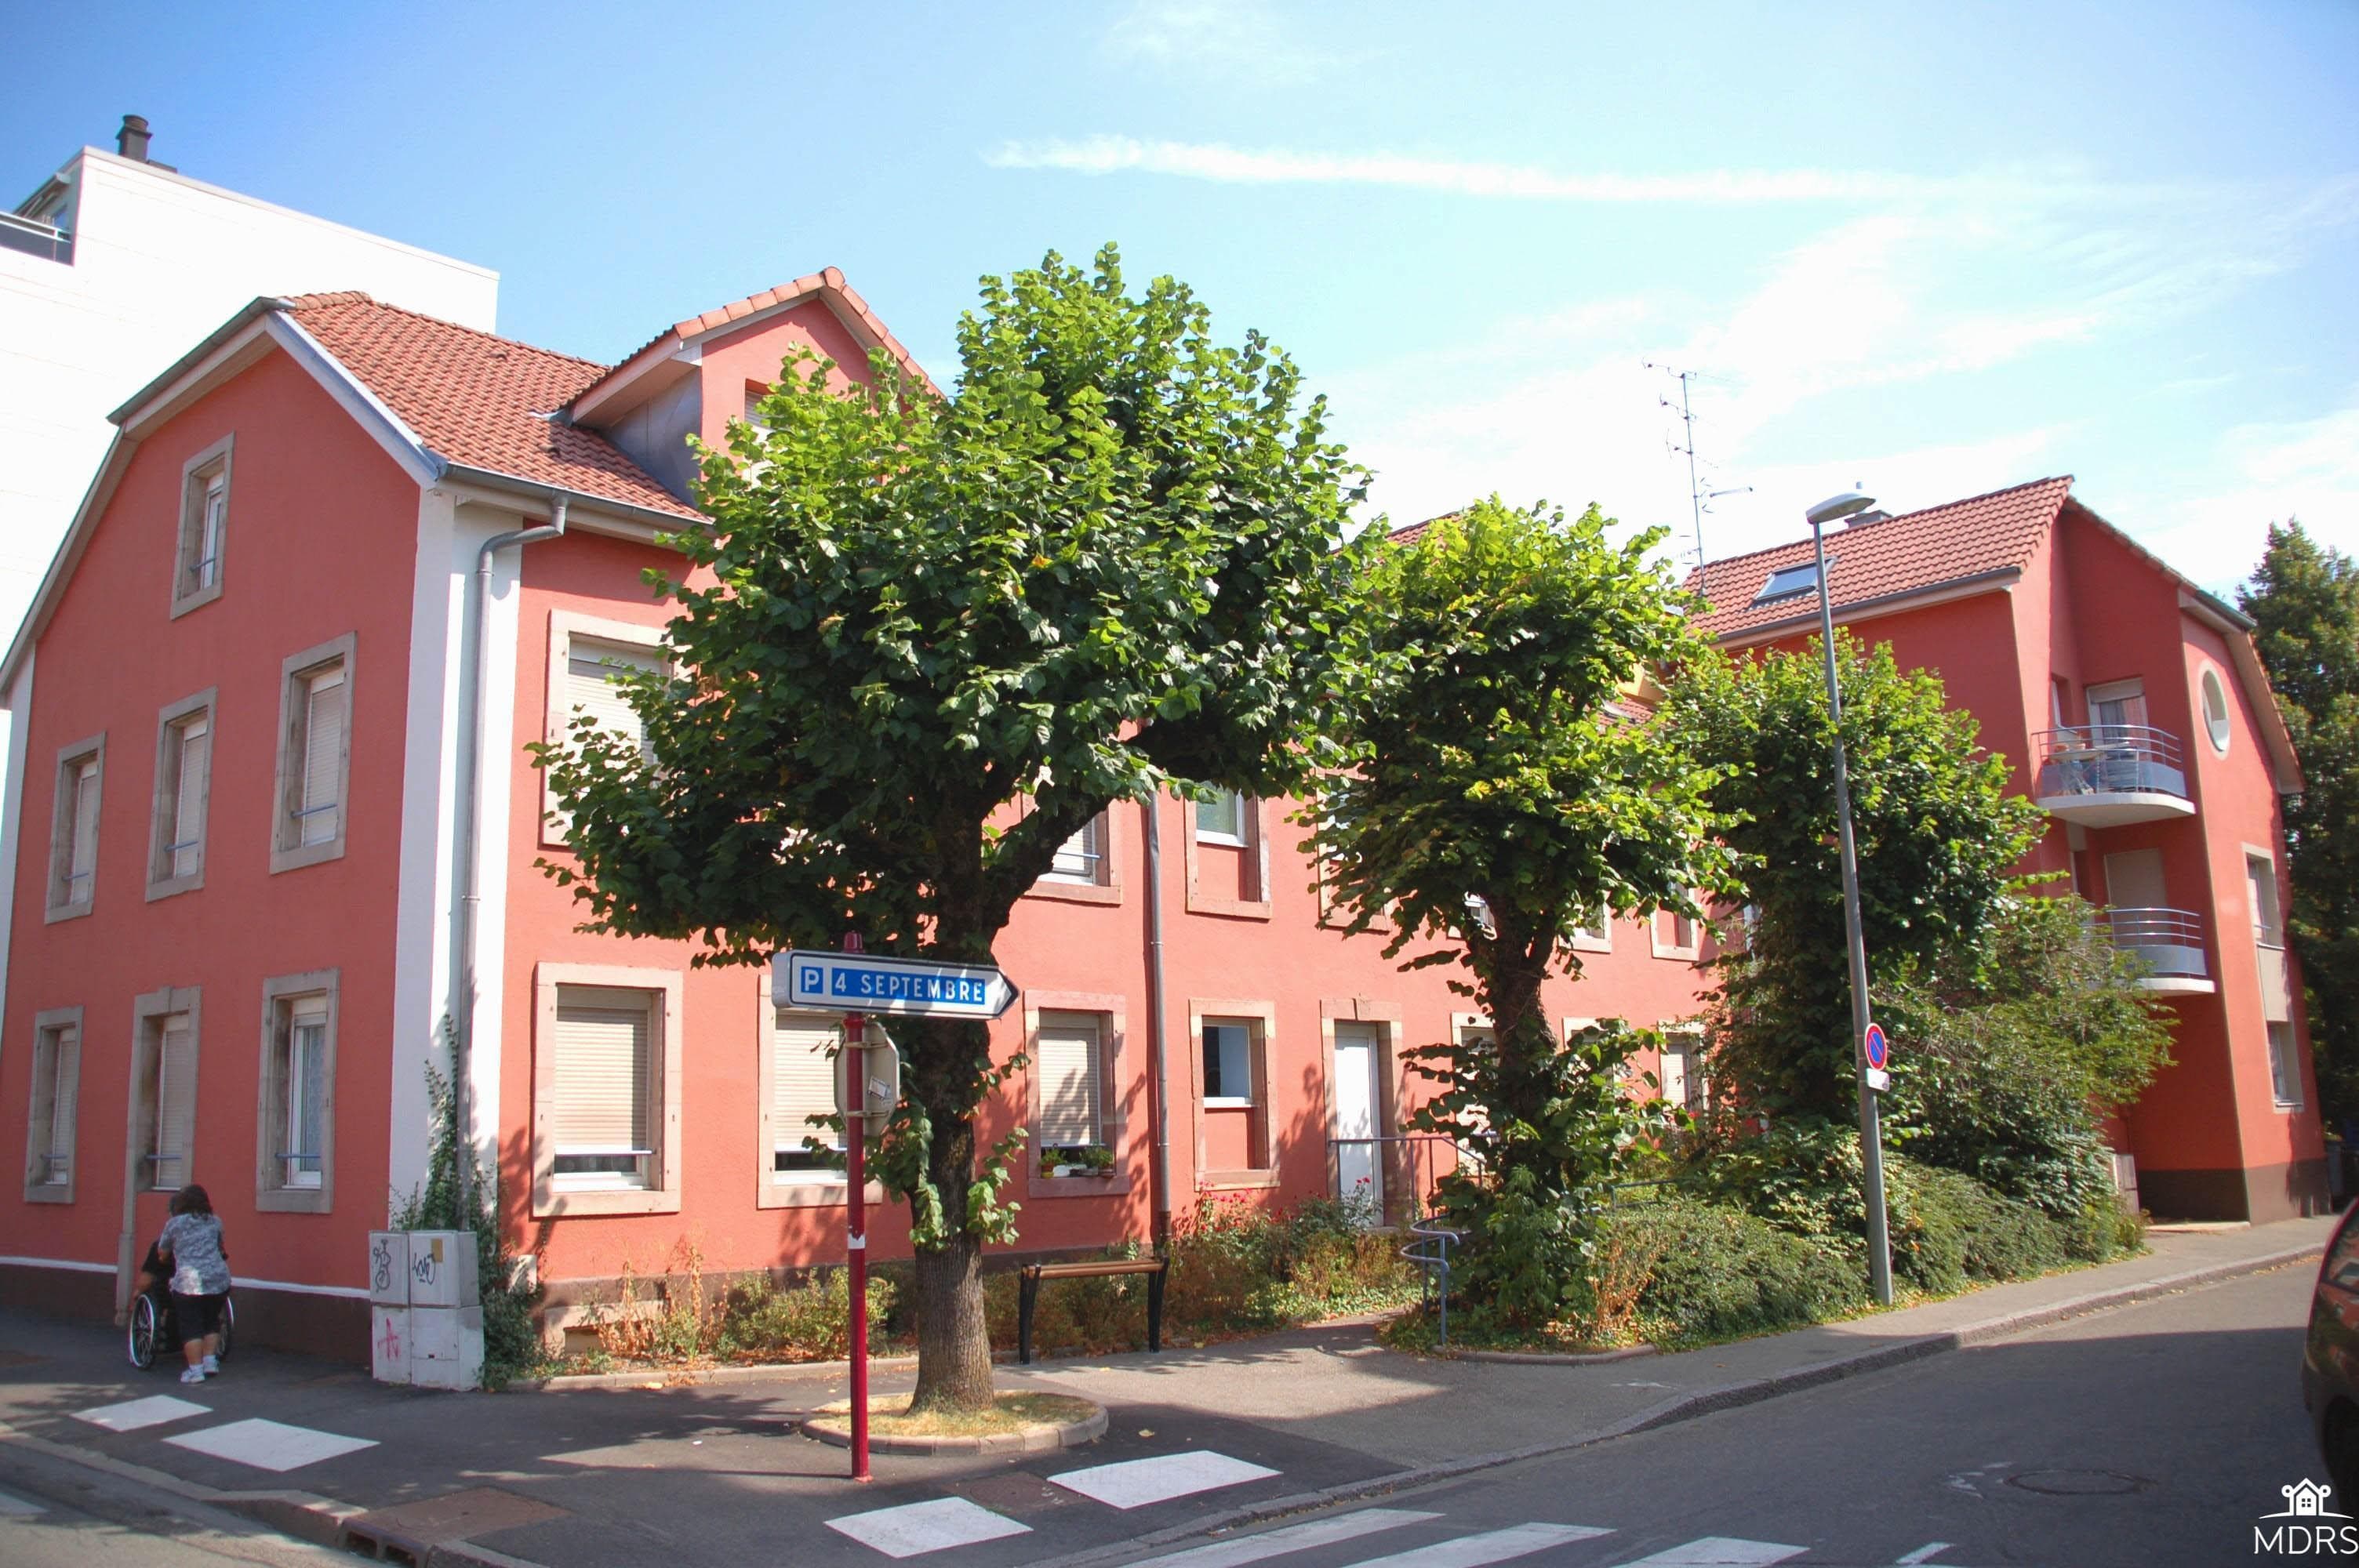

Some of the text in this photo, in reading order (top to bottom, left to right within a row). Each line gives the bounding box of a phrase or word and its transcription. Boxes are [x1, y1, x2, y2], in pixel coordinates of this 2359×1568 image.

[804, 969, 983, 1002] P 4 SEPTEMBRE
